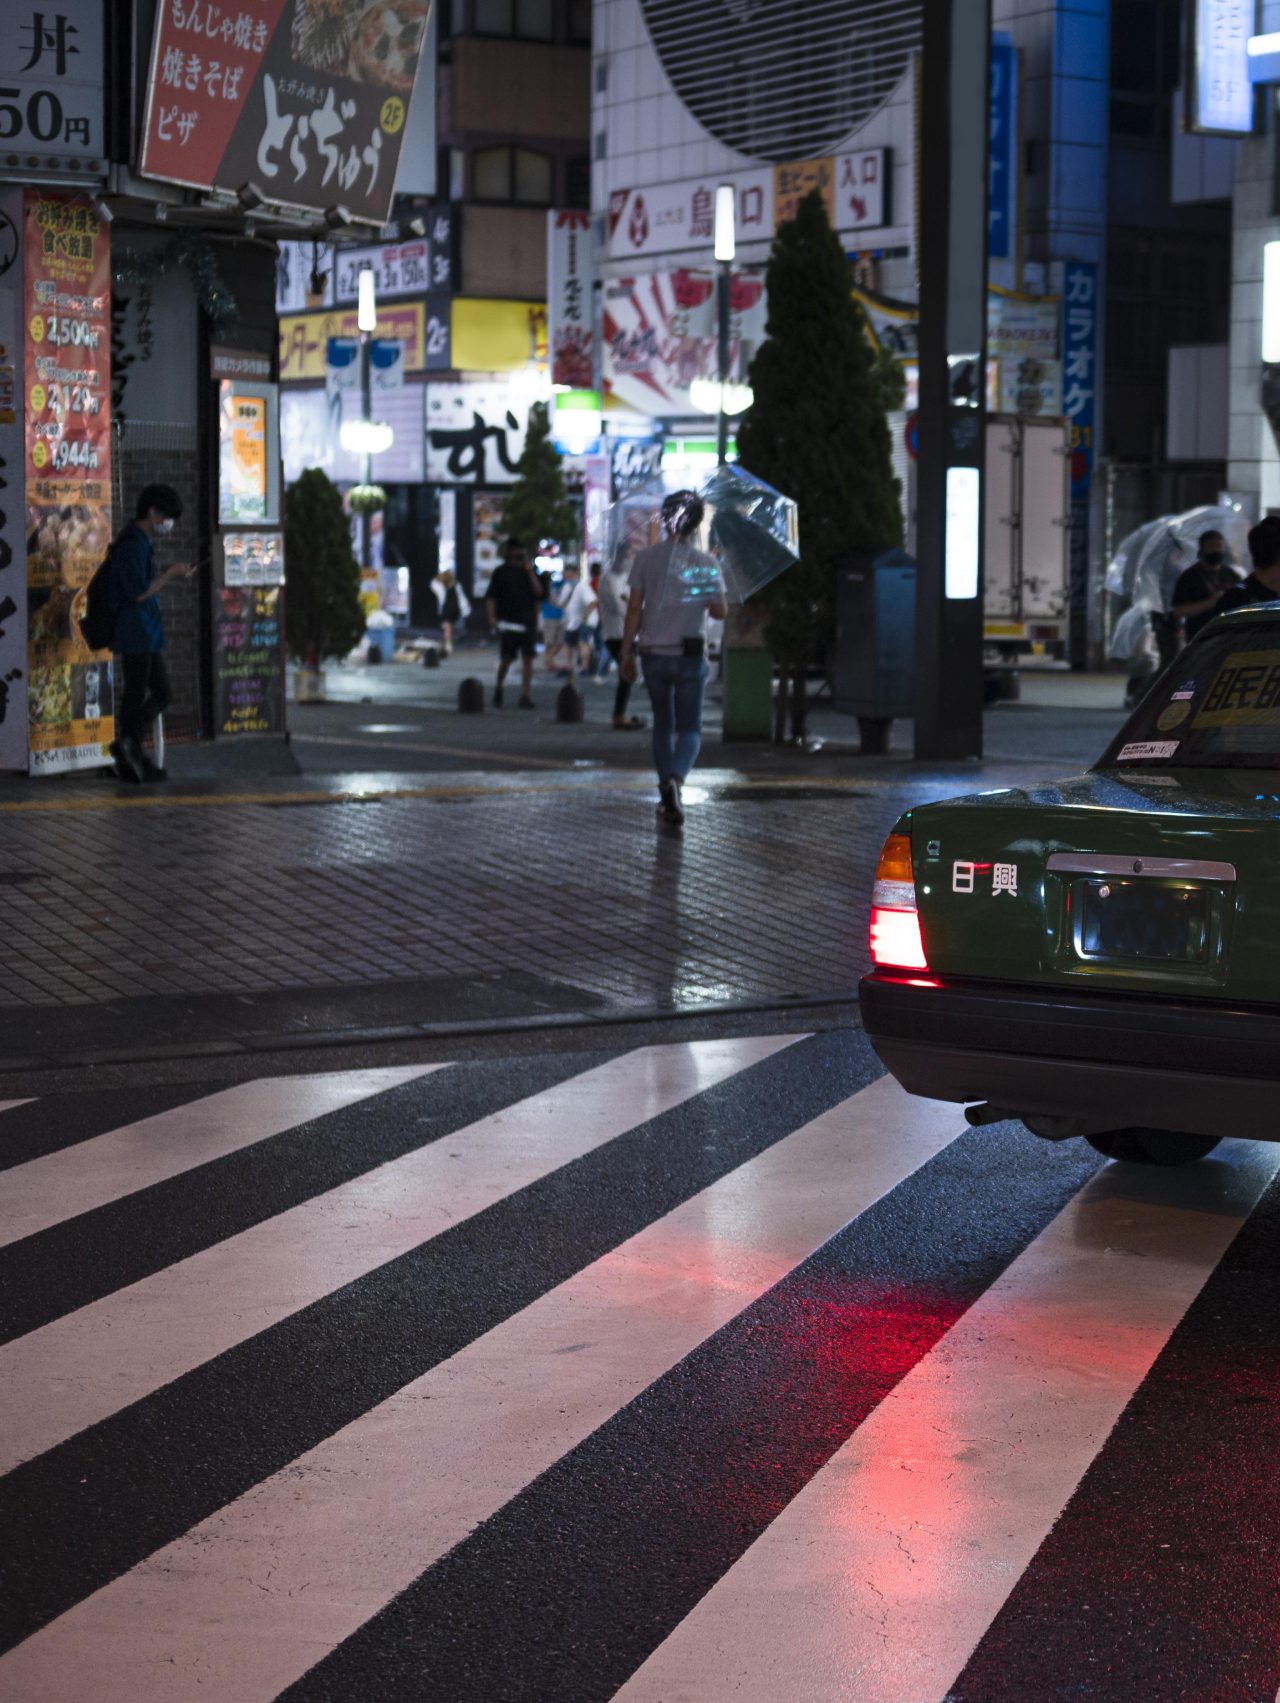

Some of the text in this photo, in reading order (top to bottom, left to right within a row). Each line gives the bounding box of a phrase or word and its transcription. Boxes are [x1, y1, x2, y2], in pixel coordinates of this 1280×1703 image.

[19, 12, 80, 76] 丼
[171, 0, 268, 53] もんじゃ焼き
[162, 44, 244, 100] 焼きそば
[157, 104, 198, 146] ピザ
[383, 104, 401, 127] 2F
[840, 155, 878, 188] 入口
[1065, 269, 1094, 417] カラオケ
[952, 861, 1018, 897] 日興
